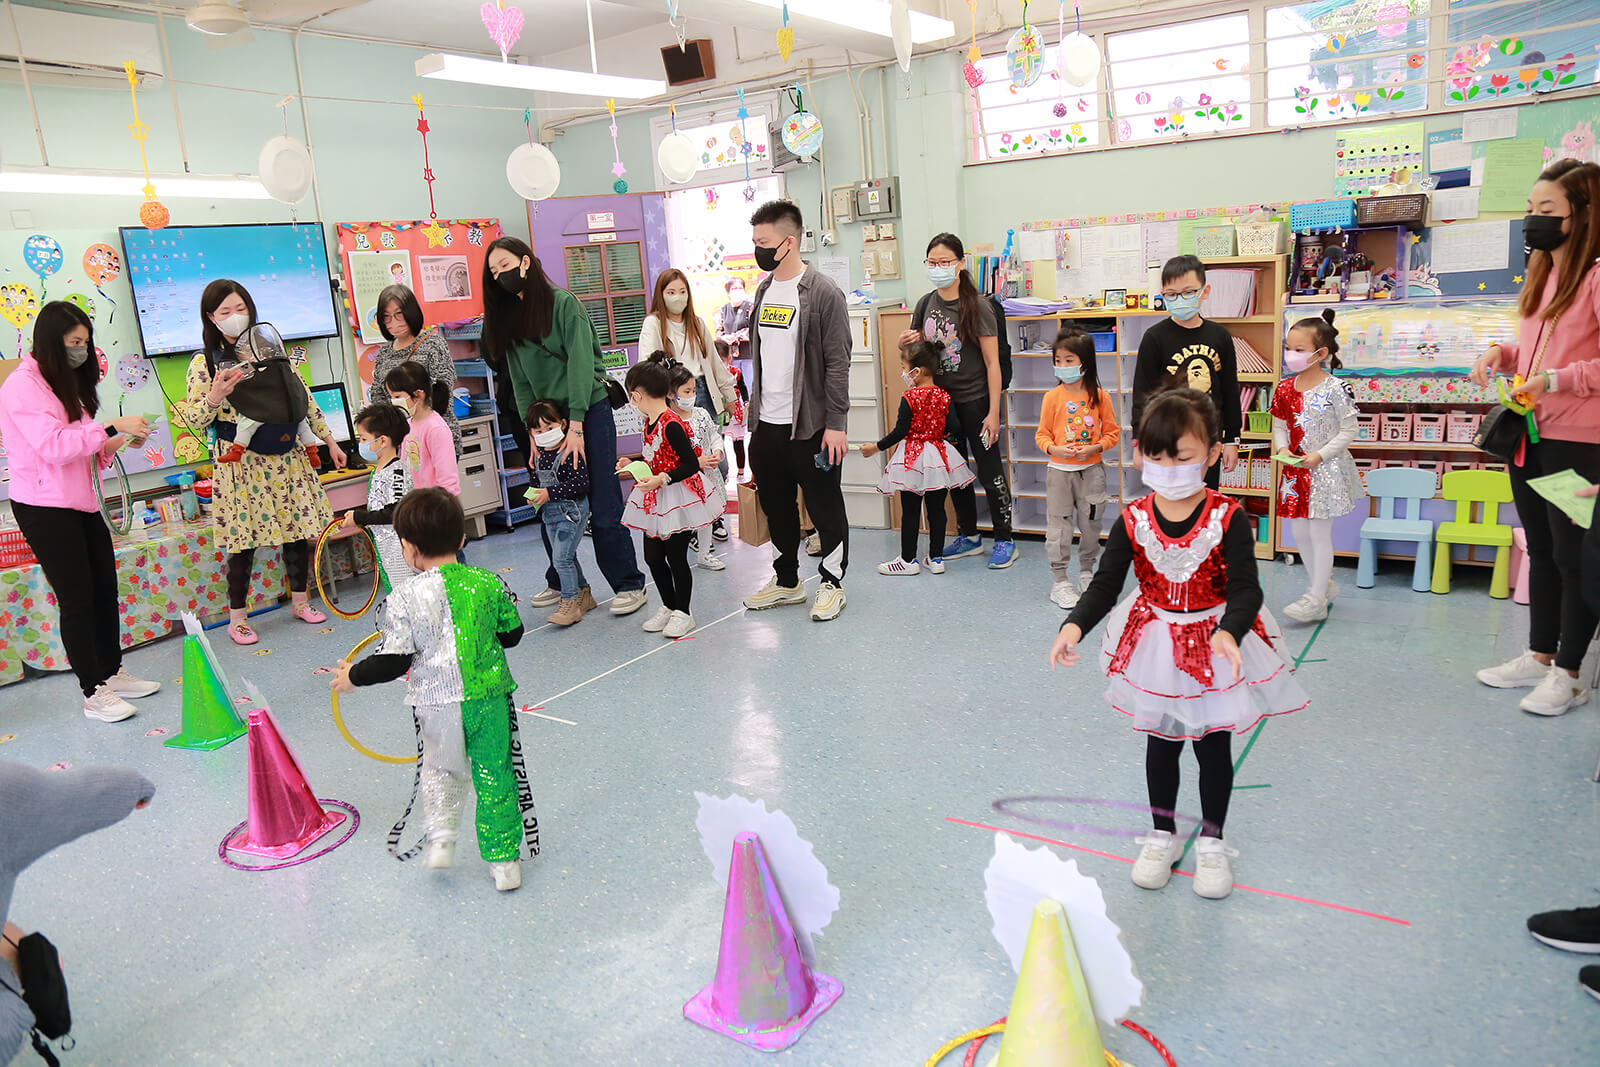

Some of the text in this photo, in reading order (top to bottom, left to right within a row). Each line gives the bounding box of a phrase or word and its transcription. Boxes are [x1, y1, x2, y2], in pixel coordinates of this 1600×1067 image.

[762, 308, 787, 322] Dickies
[289, 346, 306, 366] 享
[1166, 365, 1178, 376] A
[1390, 428, 1400, 439] D
[1424, 428, 1434, 439] E
[1457, 430, 1468, 440] F
